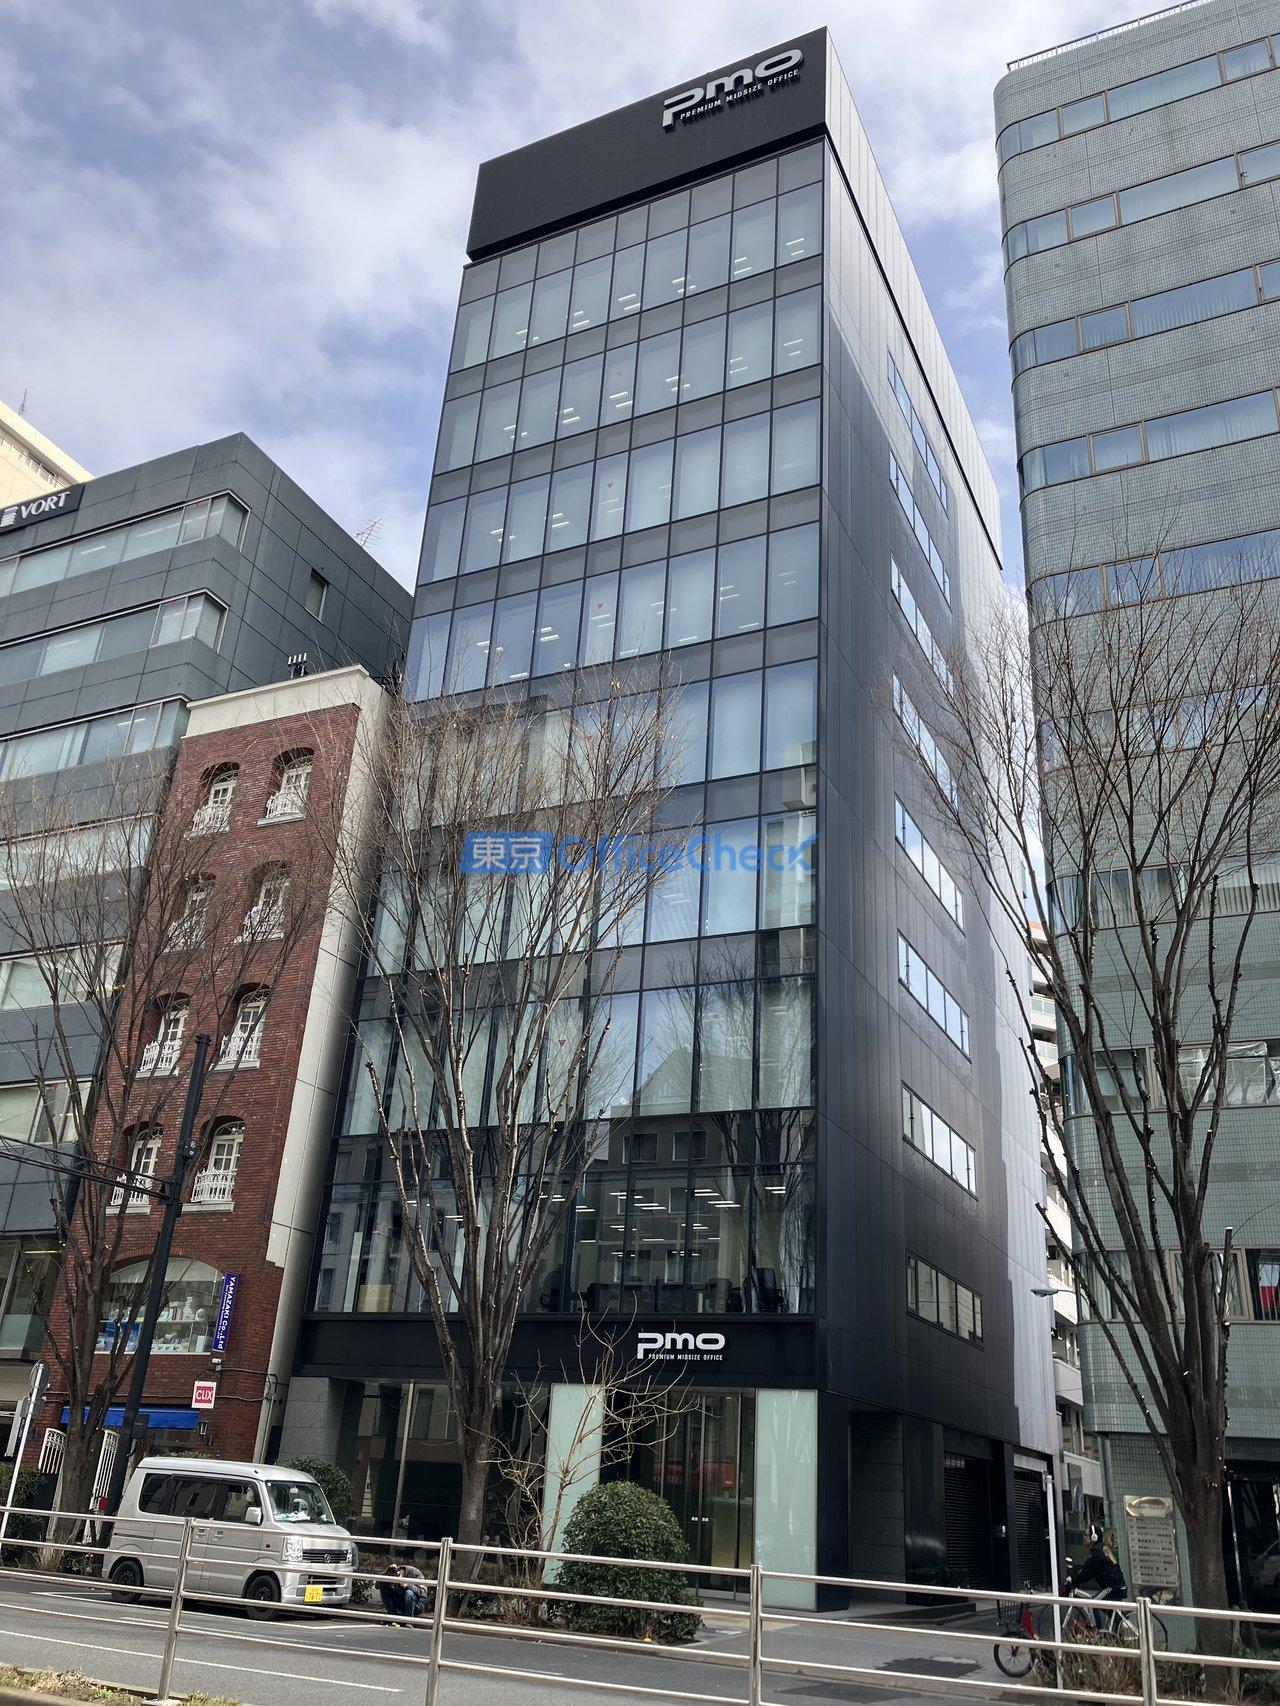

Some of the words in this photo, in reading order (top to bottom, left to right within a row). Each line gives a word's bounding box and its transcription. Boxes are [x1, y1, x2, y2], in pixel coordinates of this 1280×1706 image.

[680, 99, 721, 120] PREMIUM
[725, 82, 763, 102] MIDSIZE
[767, 68, 800, 86] OFFICE
[21, 491, 71, 519] VORT
[223, 1276, 236, 1319] YAMAZAKI
